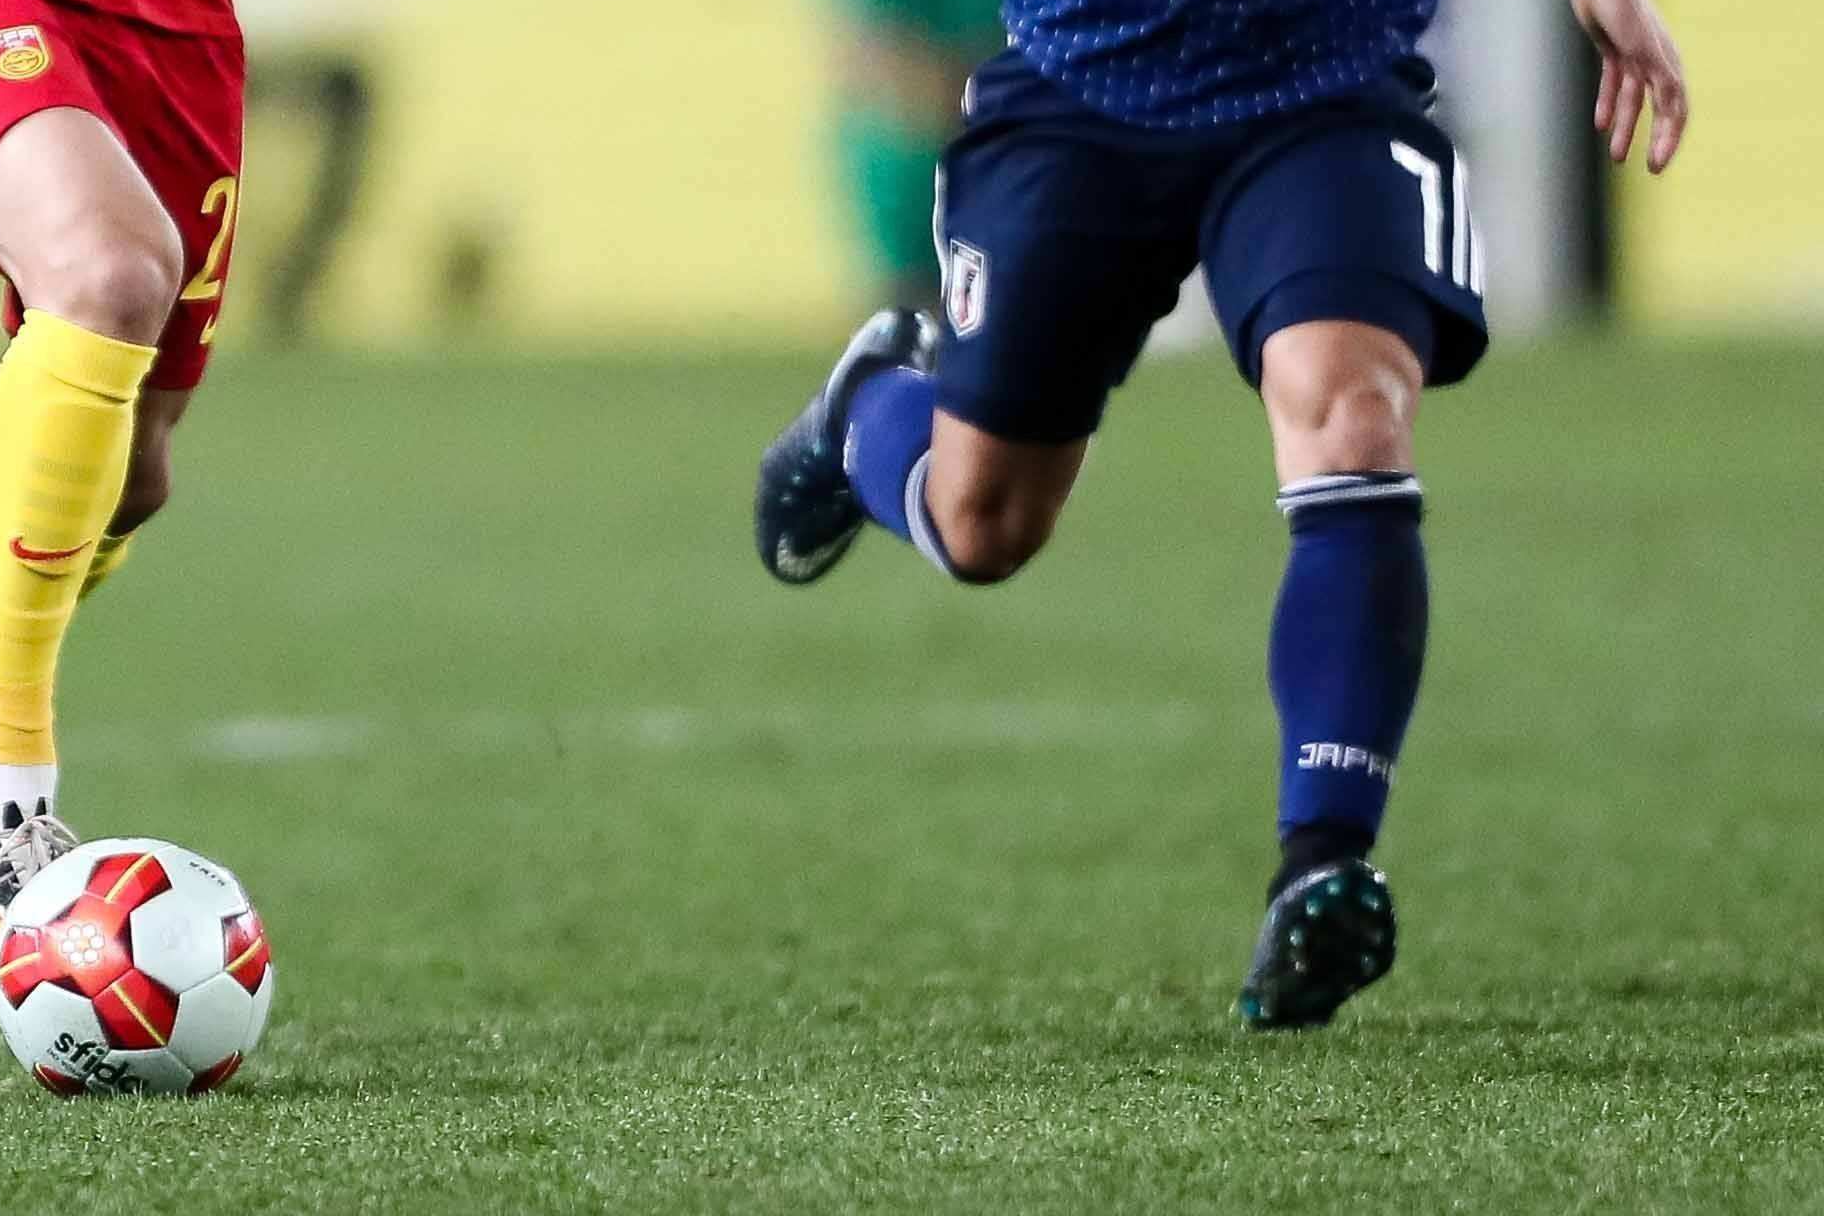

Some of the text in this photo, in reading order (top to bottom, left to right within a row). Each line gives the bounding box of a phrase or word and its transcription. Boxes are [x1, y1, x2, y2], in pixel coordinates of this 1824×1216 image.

[179, 175, 238, 301] 2
[1389, 138, 1443, 274] 7
[1297, 742, 1395, 783] JAPA
